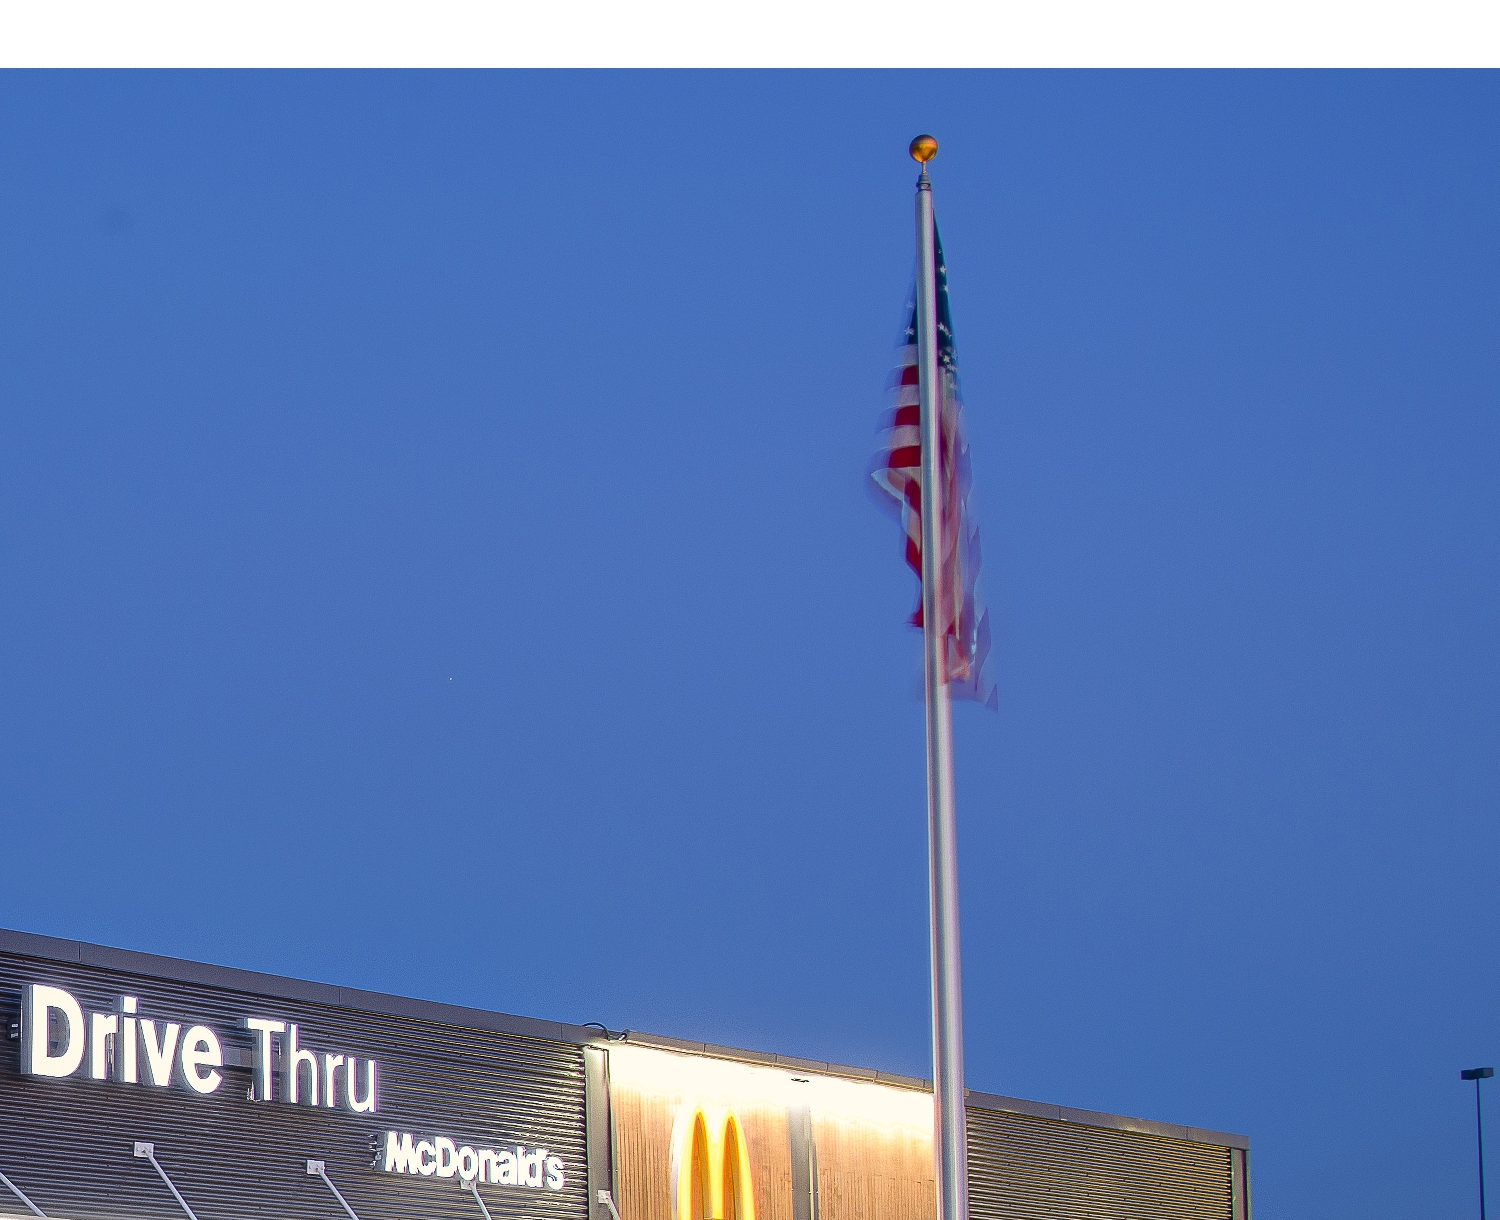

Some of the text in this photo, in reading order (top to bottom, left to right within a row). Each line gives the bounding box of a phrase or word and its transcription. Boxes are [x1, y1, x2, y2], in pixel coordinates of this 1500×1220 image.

[22, 984, 378, 1112] Drive Thru
[382, 1130, 566, 1190] McDonald's
